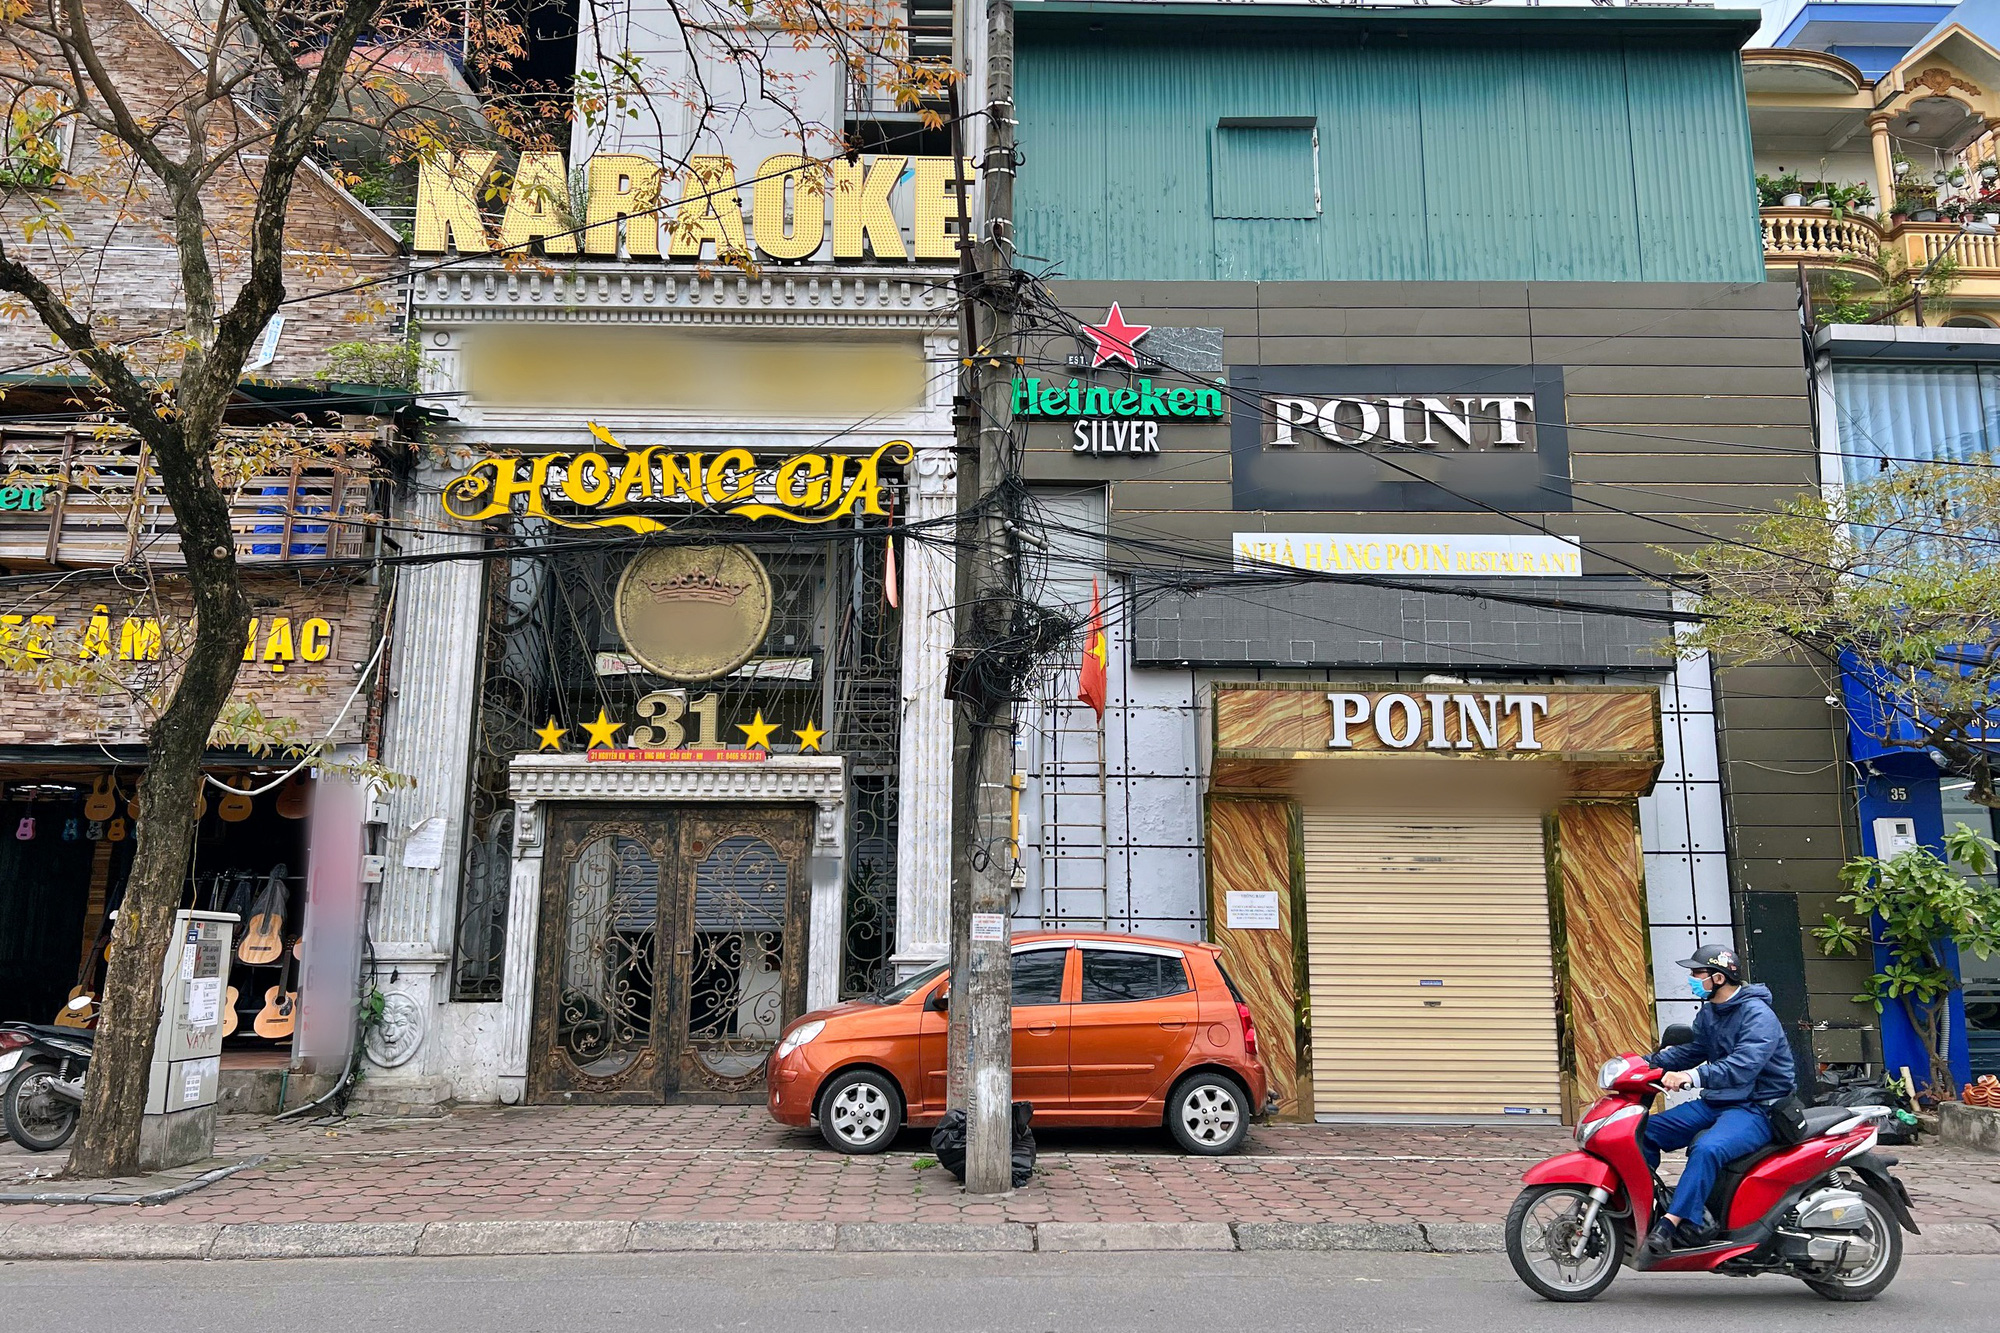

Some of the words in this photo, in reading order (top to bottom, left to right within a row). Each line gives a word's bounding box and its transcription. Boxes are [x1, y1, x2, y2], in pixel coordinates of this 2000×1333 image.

[414, 150, 976, 261] KARAOKE
[1068, 356, 1088, 365] EST.
[1011, 377, 1224, 416] Heineken
[1072, 420, 1160, 451] SILVER
[1268, 397, 1534, 446] POINT
[442, 421, 761, 533] HOÀNG
[728, 440, 914, 523] GIA
[1239, 538, 1295, 568] NHÀ
[1303, 538, 1382, 571] HÀNG
[1386, 542, 1449, 572] POIN
[1456, 551, 1579, 574] RESTAURANT
[79, 604, 161, 661] ÂM
[633, 693, 727, 750] 31
[1328, 693, 1548, 750] POINT
[1890, 787, 1907, 801] 35
